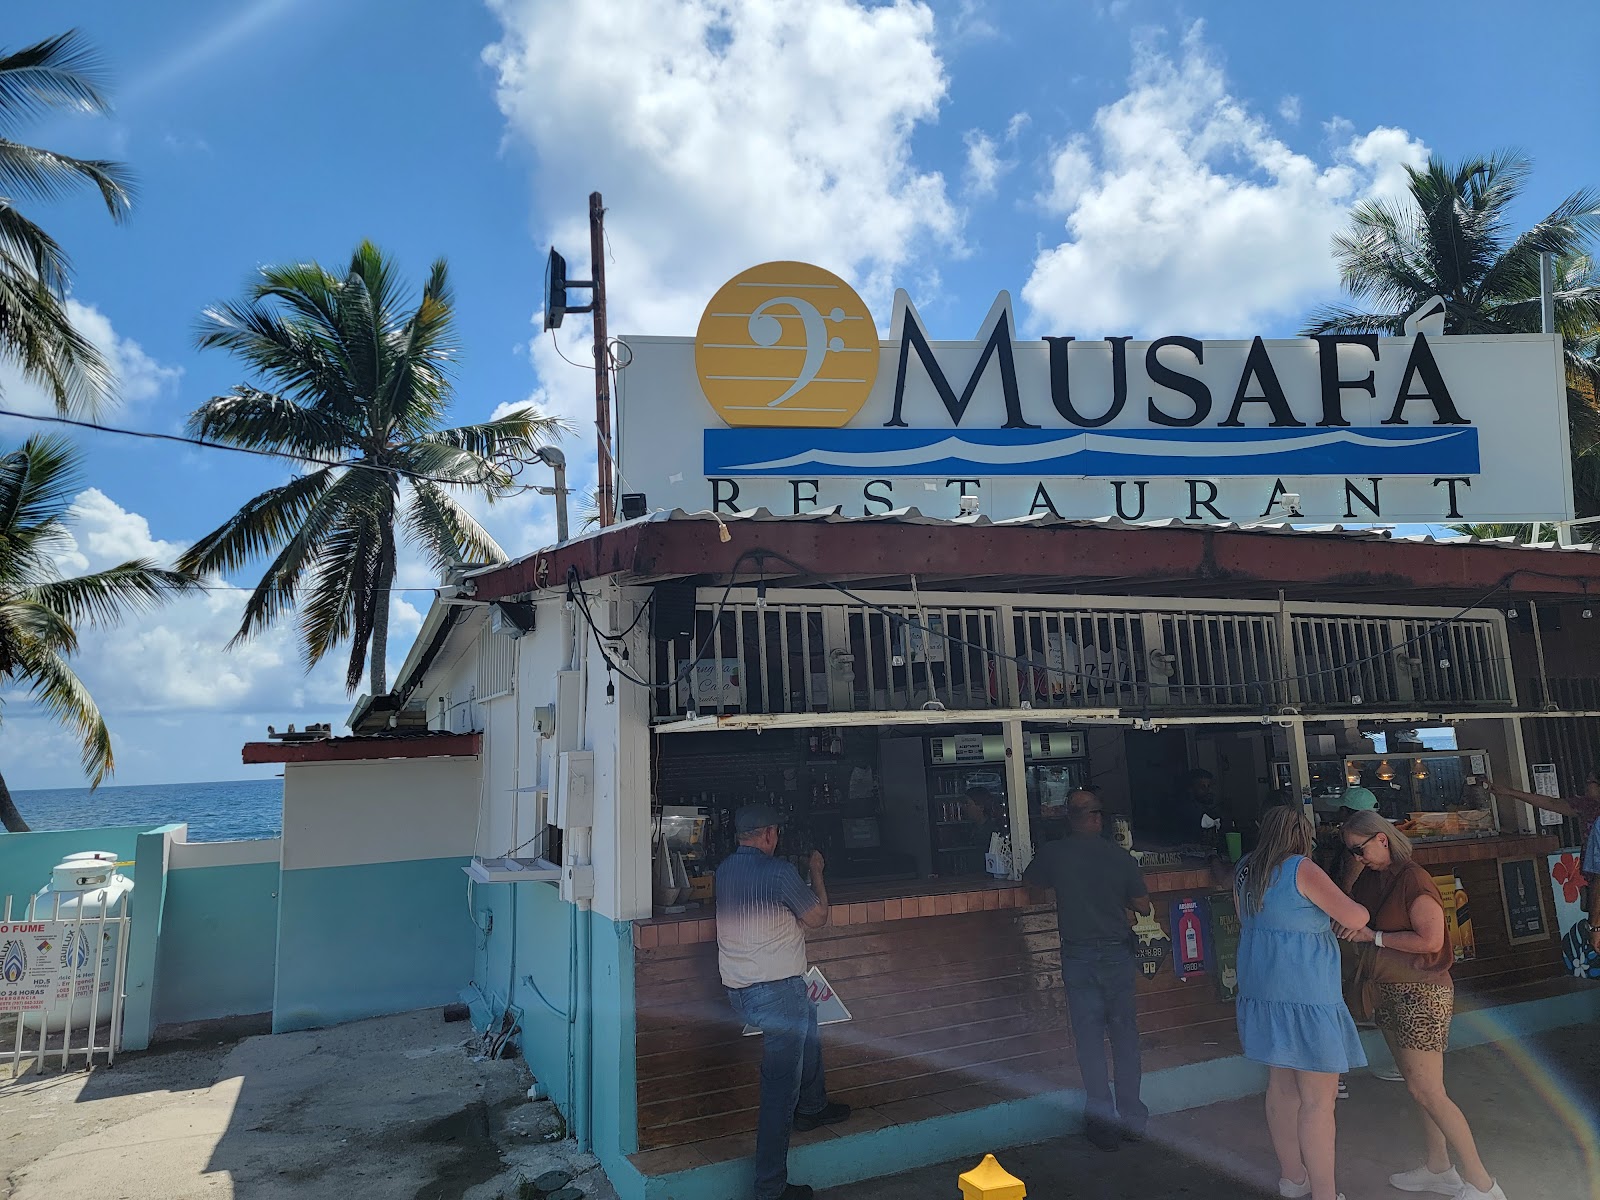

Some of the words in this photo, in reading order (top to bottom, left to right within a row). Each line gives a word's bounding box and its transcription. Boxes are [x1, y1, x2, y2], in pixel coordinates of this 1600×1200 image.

[883, 302, 1471, 428] MUSAFÁ
[707, 477, 1472, 521] RESTAURANT
[13, 925, 45, 933] FUME
[61, 930, 75, 968] LIQUILUX
